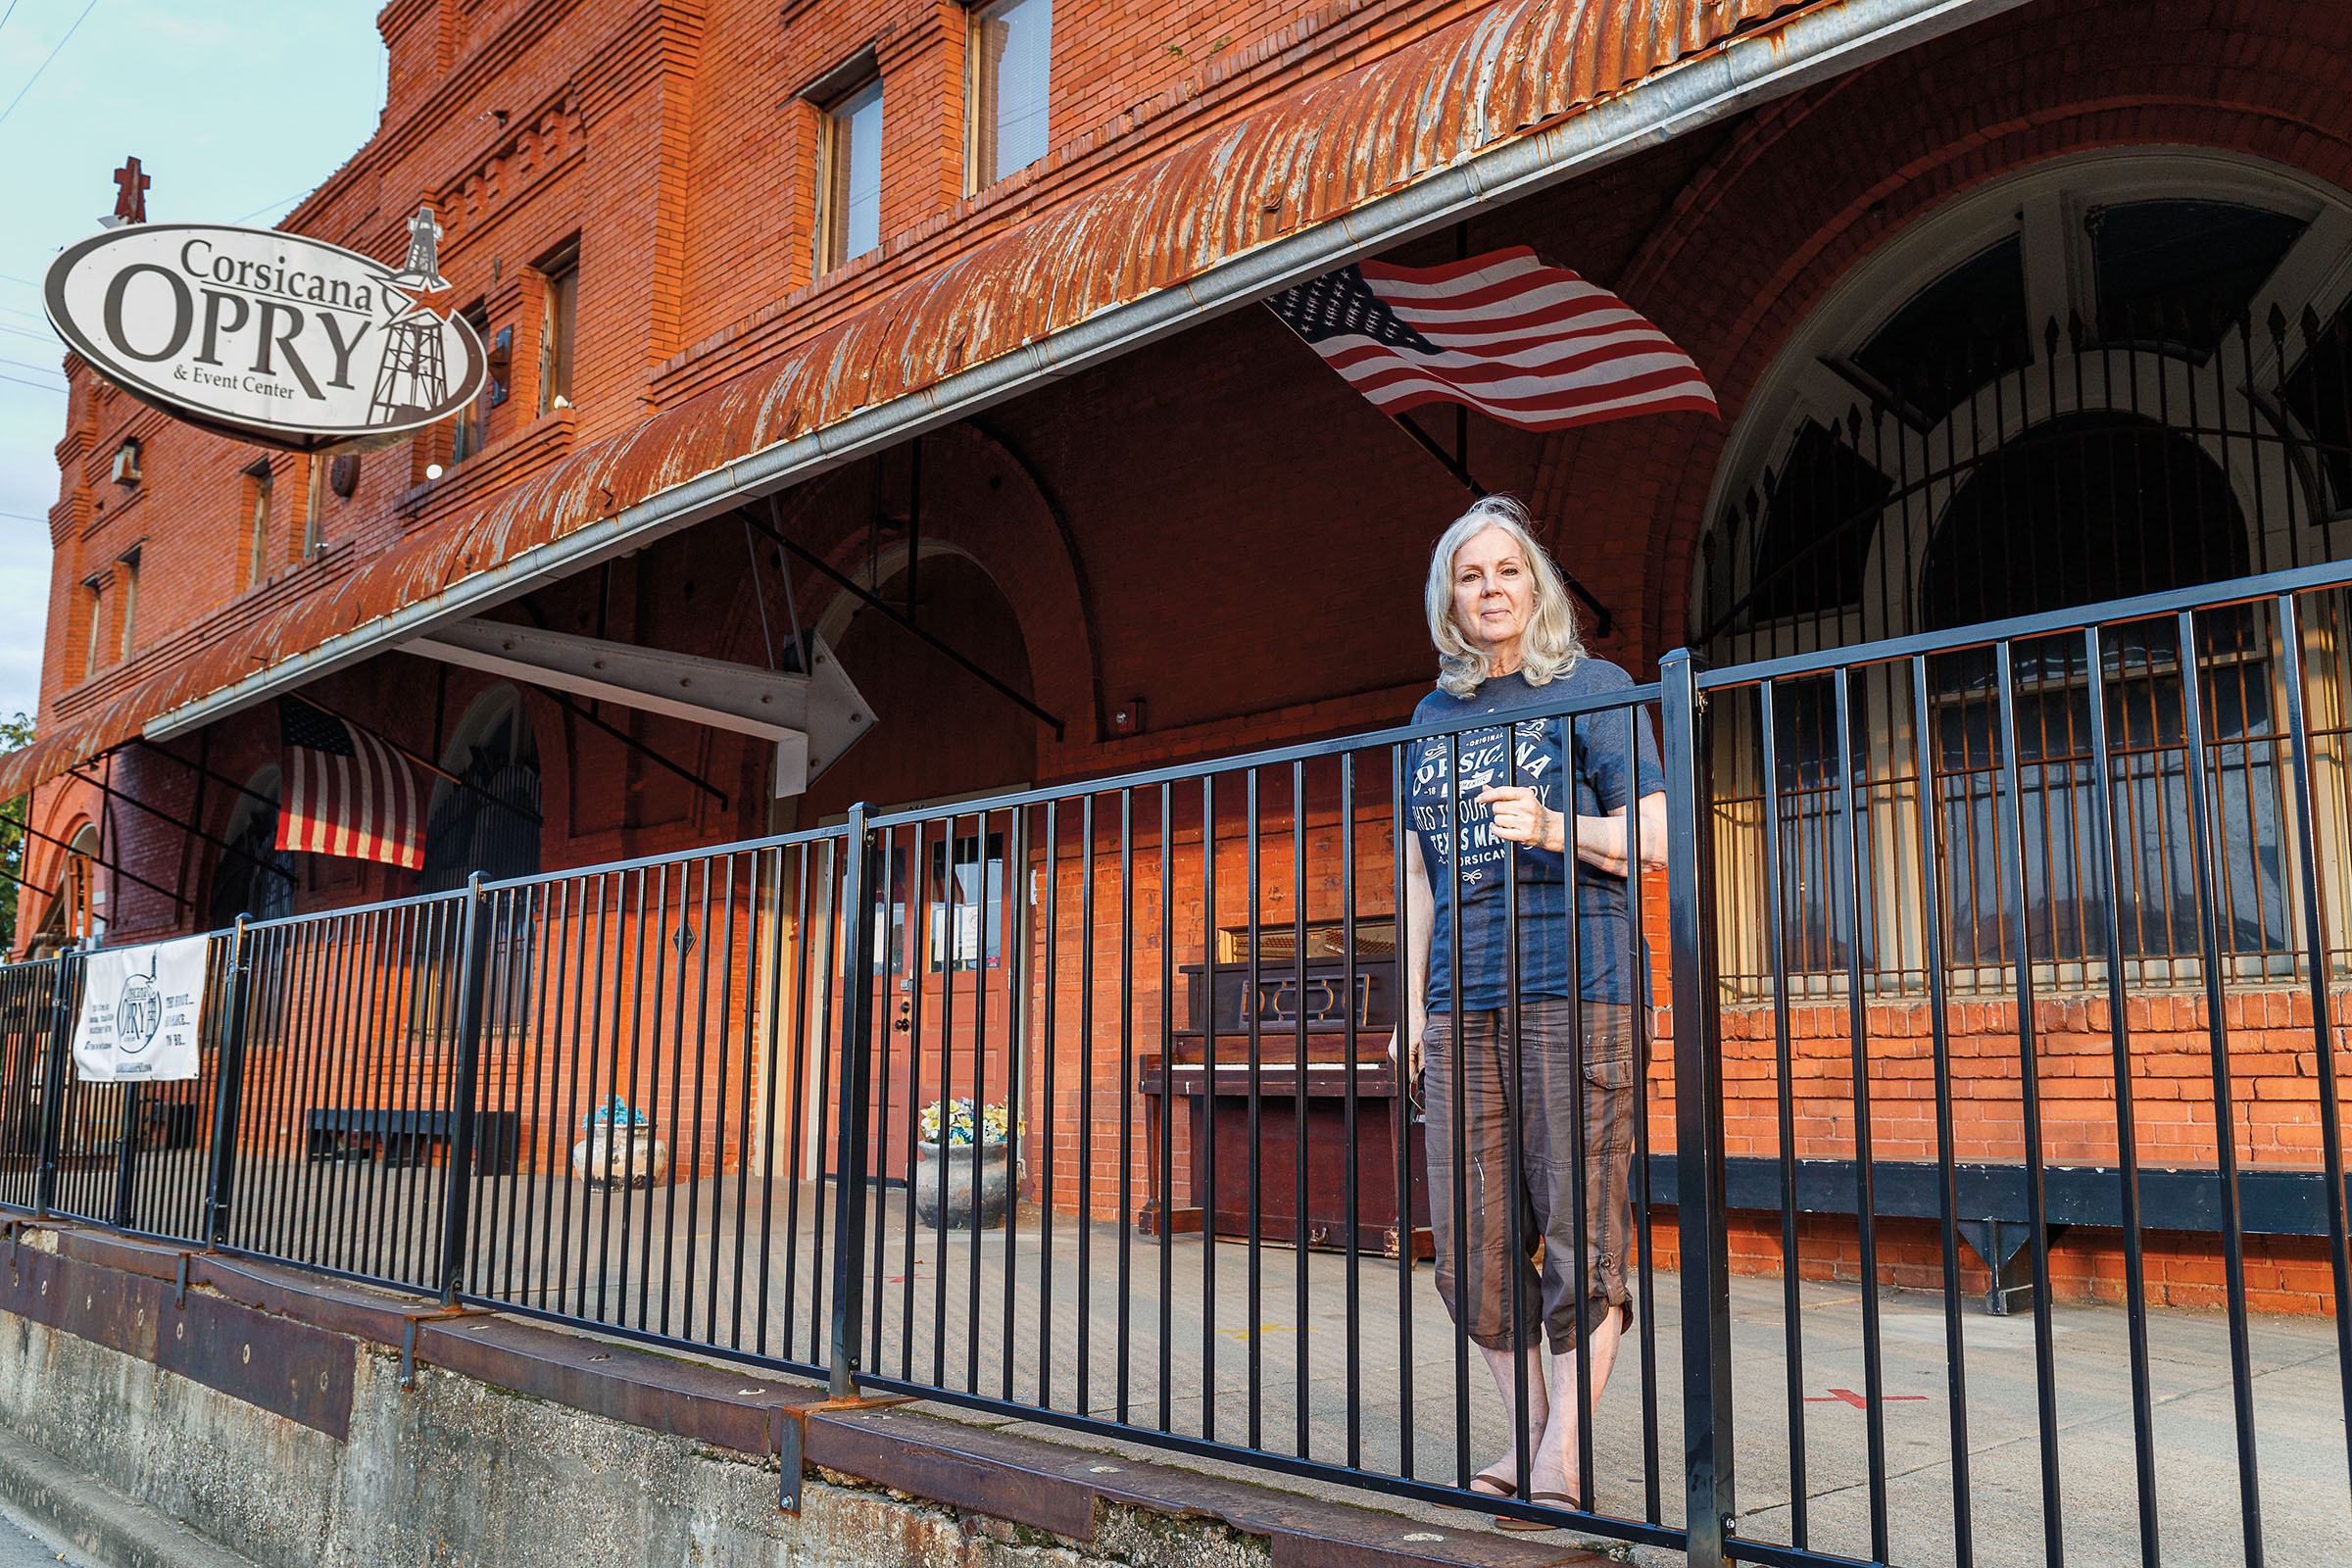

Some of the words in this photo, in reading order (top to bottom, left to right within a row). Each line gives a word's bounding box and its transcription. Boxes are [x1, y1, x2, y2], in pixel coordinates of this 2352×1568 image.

[180, 239, 373, 313] Corsicana
[104, 263, 372, 401] OPRY
[173, 364, 187, 381] &
[193, 367, 238, 391] Event
[242, 375, 295, 401] Center
[1412, 741, 1552, 798] COSICNA
[1438, 804, 1448, 828] I
[1431, 827, 1469, 856] TEXS
